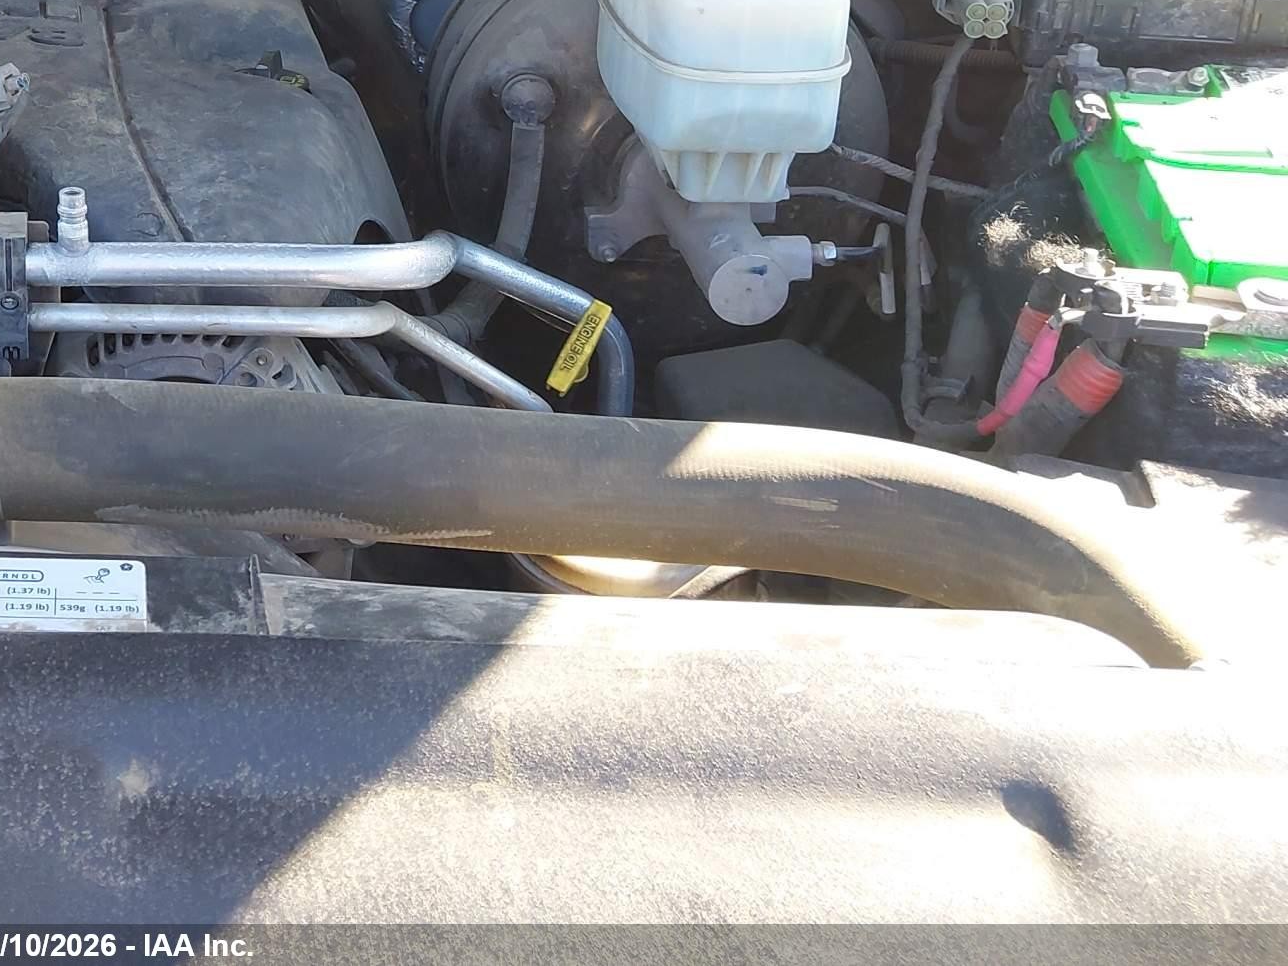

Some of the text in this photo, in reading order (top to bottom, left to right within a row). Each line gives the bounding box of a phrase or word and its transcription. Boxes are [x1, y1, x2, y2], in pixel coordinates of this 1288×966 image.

[559, 314, 601, 371] ENGINE OIL
[7, 586, 35, 596] (1.37
[36, 586, 52, 596] lb)
[5, 602, 33, 612] (1.19
[35, 603, 51, 612] lb)
[59, 604, 140, 614] 539g (1.19 lb)
